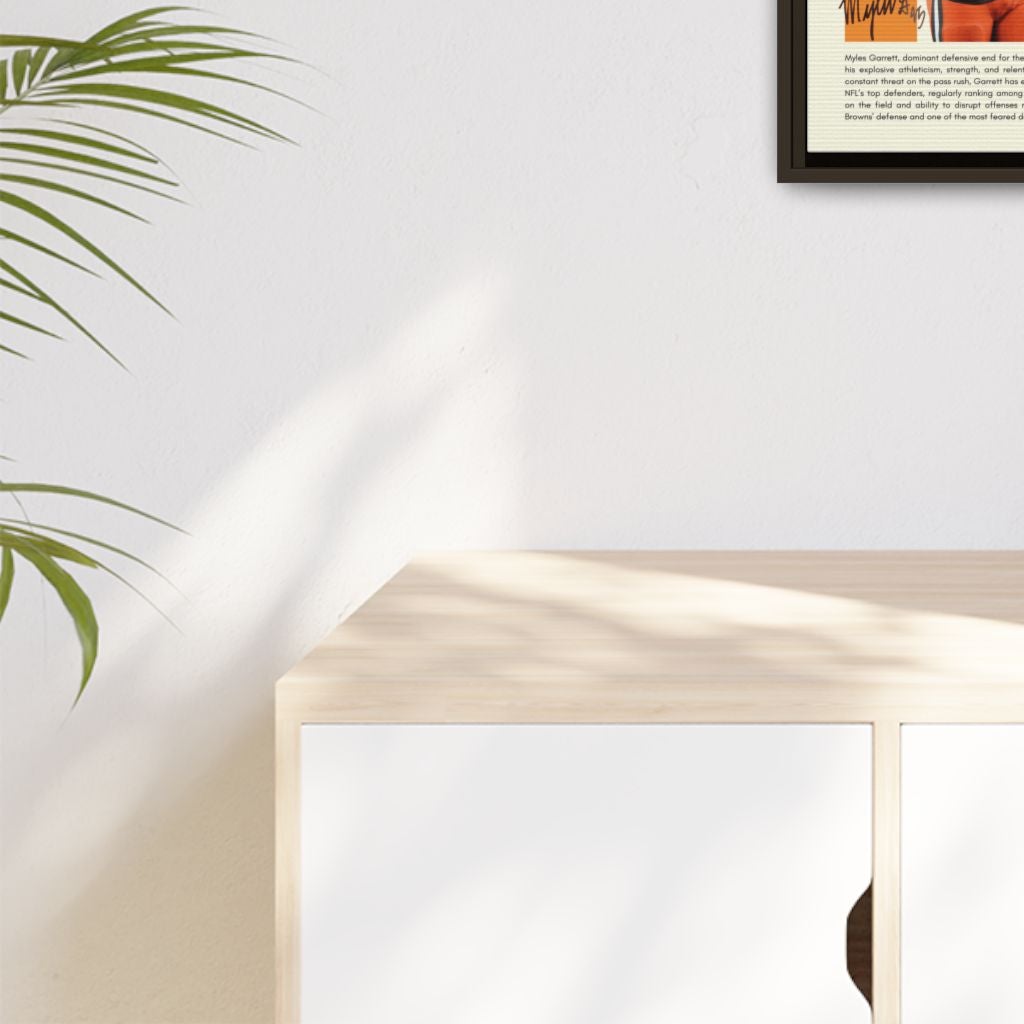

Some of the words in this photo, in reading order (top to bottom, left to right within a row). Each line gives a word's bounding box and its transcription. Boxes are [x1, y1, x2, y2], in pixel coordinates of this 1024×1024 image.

[844, 54, 866, 63] Myles
[868, 54, 900, 63] Garrett,
[902, 54, 939, 62] dominant
[941, 54, 979, 62] defensive
[981, 54, 996, 62] end
[998, 54, 1009, 62] for
[1012, 54, 1024, 62] the
[844, 65, 856, 73] his
[859, 65, 895, 75] explosive
[898, 65, 943, 74] athleticism,
[946, 65, 980, 75] strength,
[984, 65, 1000, 73] and
[844, 77, 878, 85] constant
[881, 77, 904, 85] threat
[919, 77, 931, 85] the
[933, 79, 951, 87] pass
[953, 77, 971, 86] rush,
[974, 77, 1002, 85] Garrett
[1004, 77, 1018, 85] has
[844, 89, 865, 97] NFL's
[867, 89, 880, 99] top
[883, 89, 925, 98] defenders,
[928, 89, 962, 99] regularly
[965, 89, 993, 99] ranking
[996, 91, 1023, 99] among
[858, 101, 871, 109] the
[875, 101, 893, 109] field
[896, 101, 912, 109] and
[915, 101, 939, 111] ability
[954, 101, 981, 111] disrupt
[985, 101, 1018, 109] offenses
